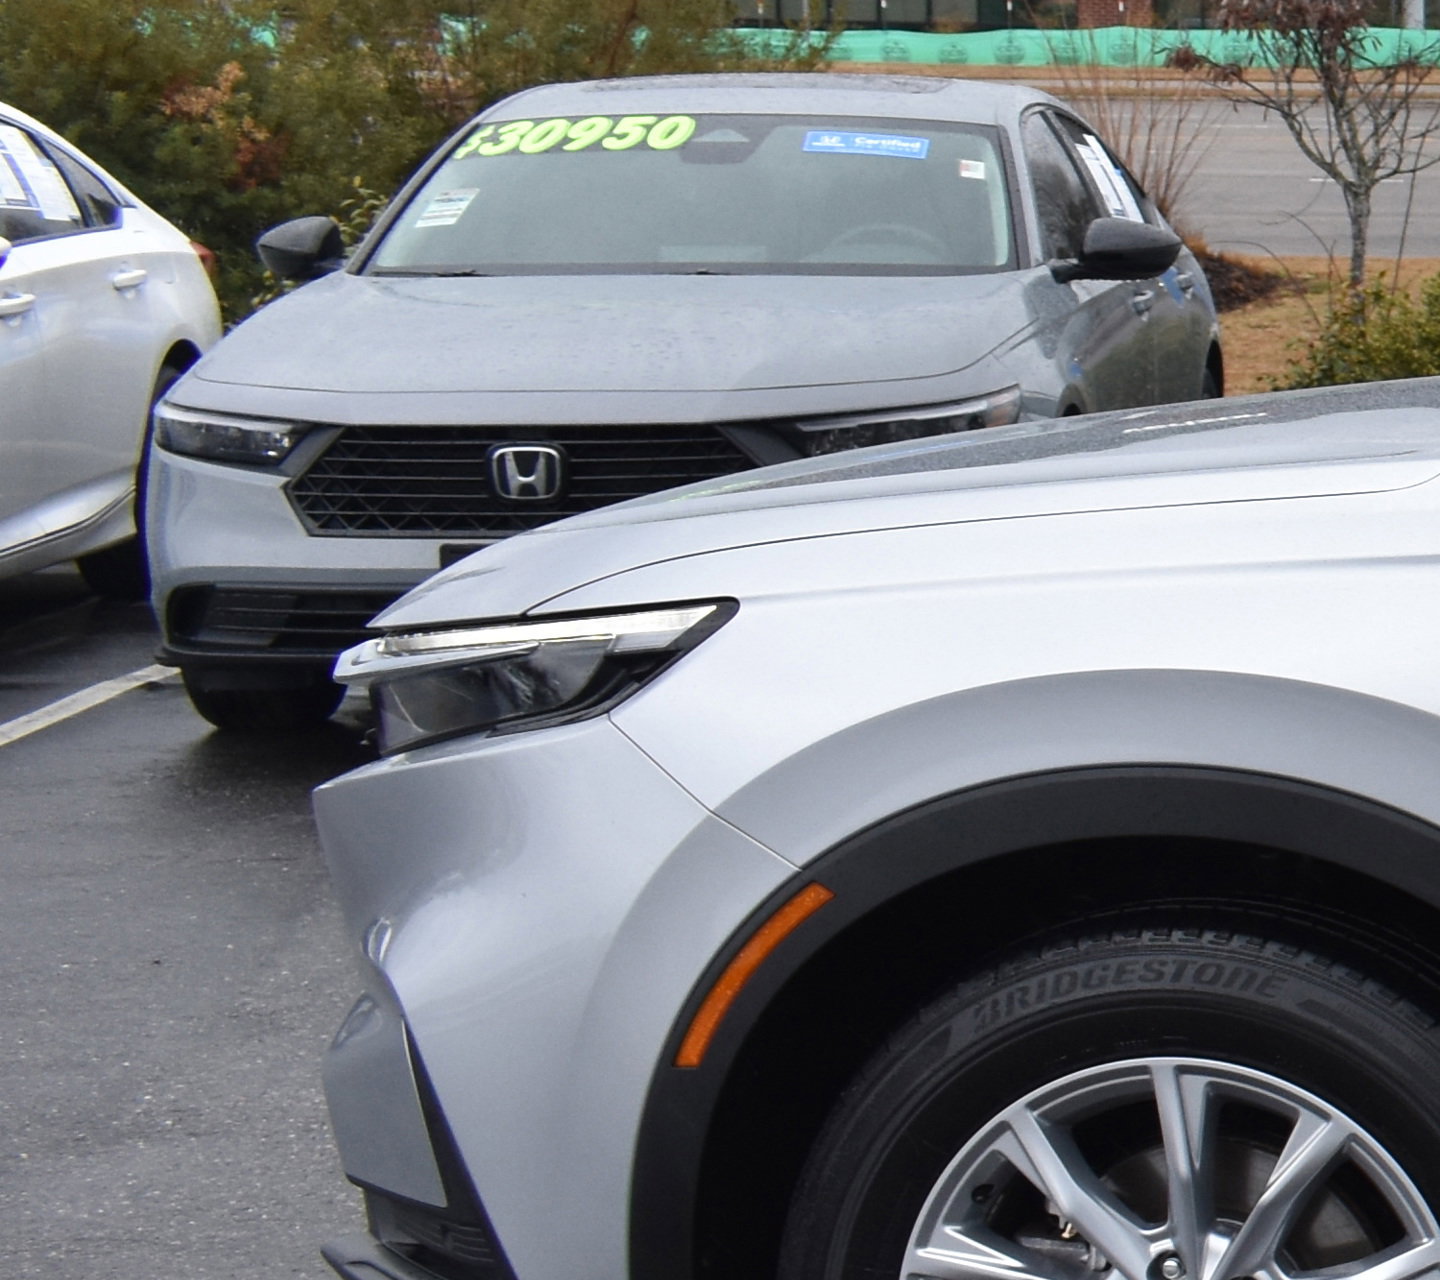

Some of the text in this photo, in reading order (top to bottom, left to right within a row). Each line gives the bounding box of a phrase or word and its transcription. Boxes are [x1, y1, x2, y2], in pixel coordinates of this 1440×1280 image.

[453, 115, 697, 160] $30950
[854, 136, 922, 149] Certified
[970, 958, 1291, 1036] BRIDGESTONE
